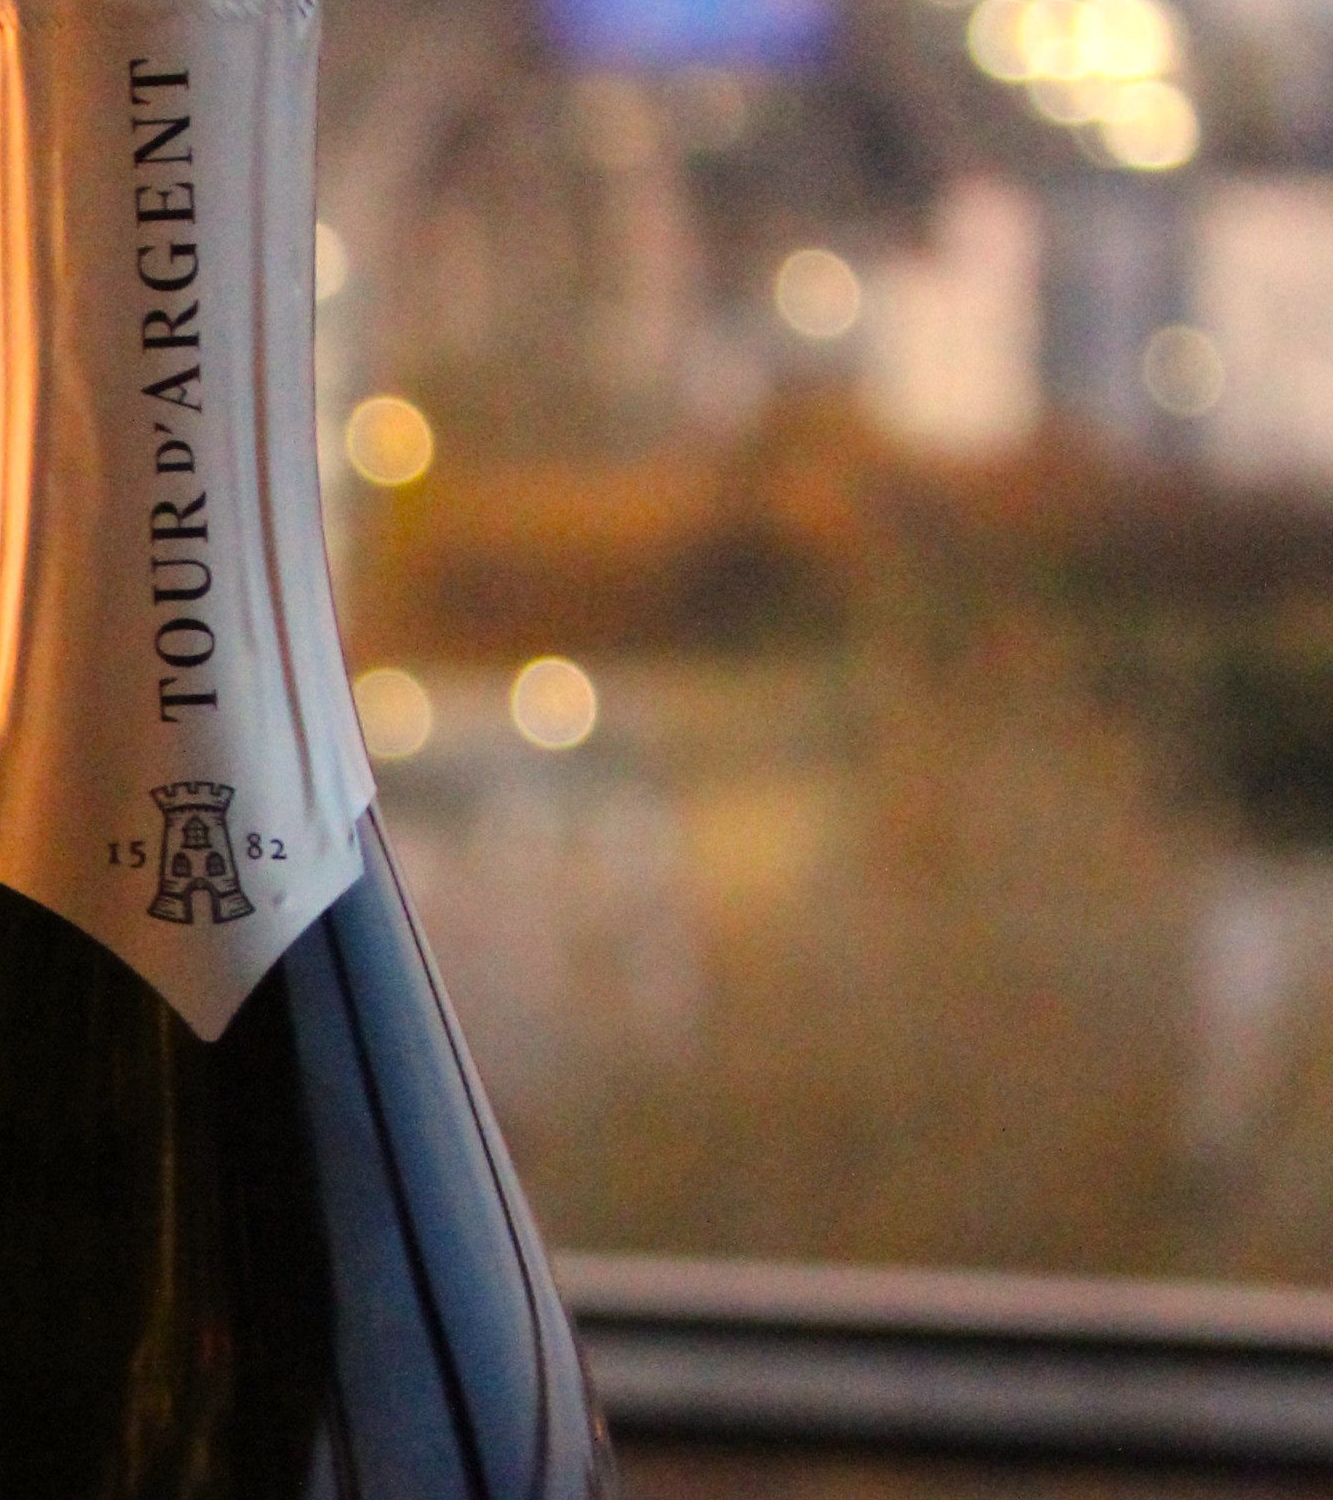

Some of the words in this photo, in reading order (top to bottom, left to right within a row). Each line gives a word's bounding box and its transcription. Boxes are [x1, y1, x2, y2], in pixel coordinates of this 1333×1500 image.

[128, 57, 203, 475] D'ARGENT
[150, 491, 219, 724] TOUR
[107, 841, 147, 868] 15
[246, 832, 288, 860] 82
